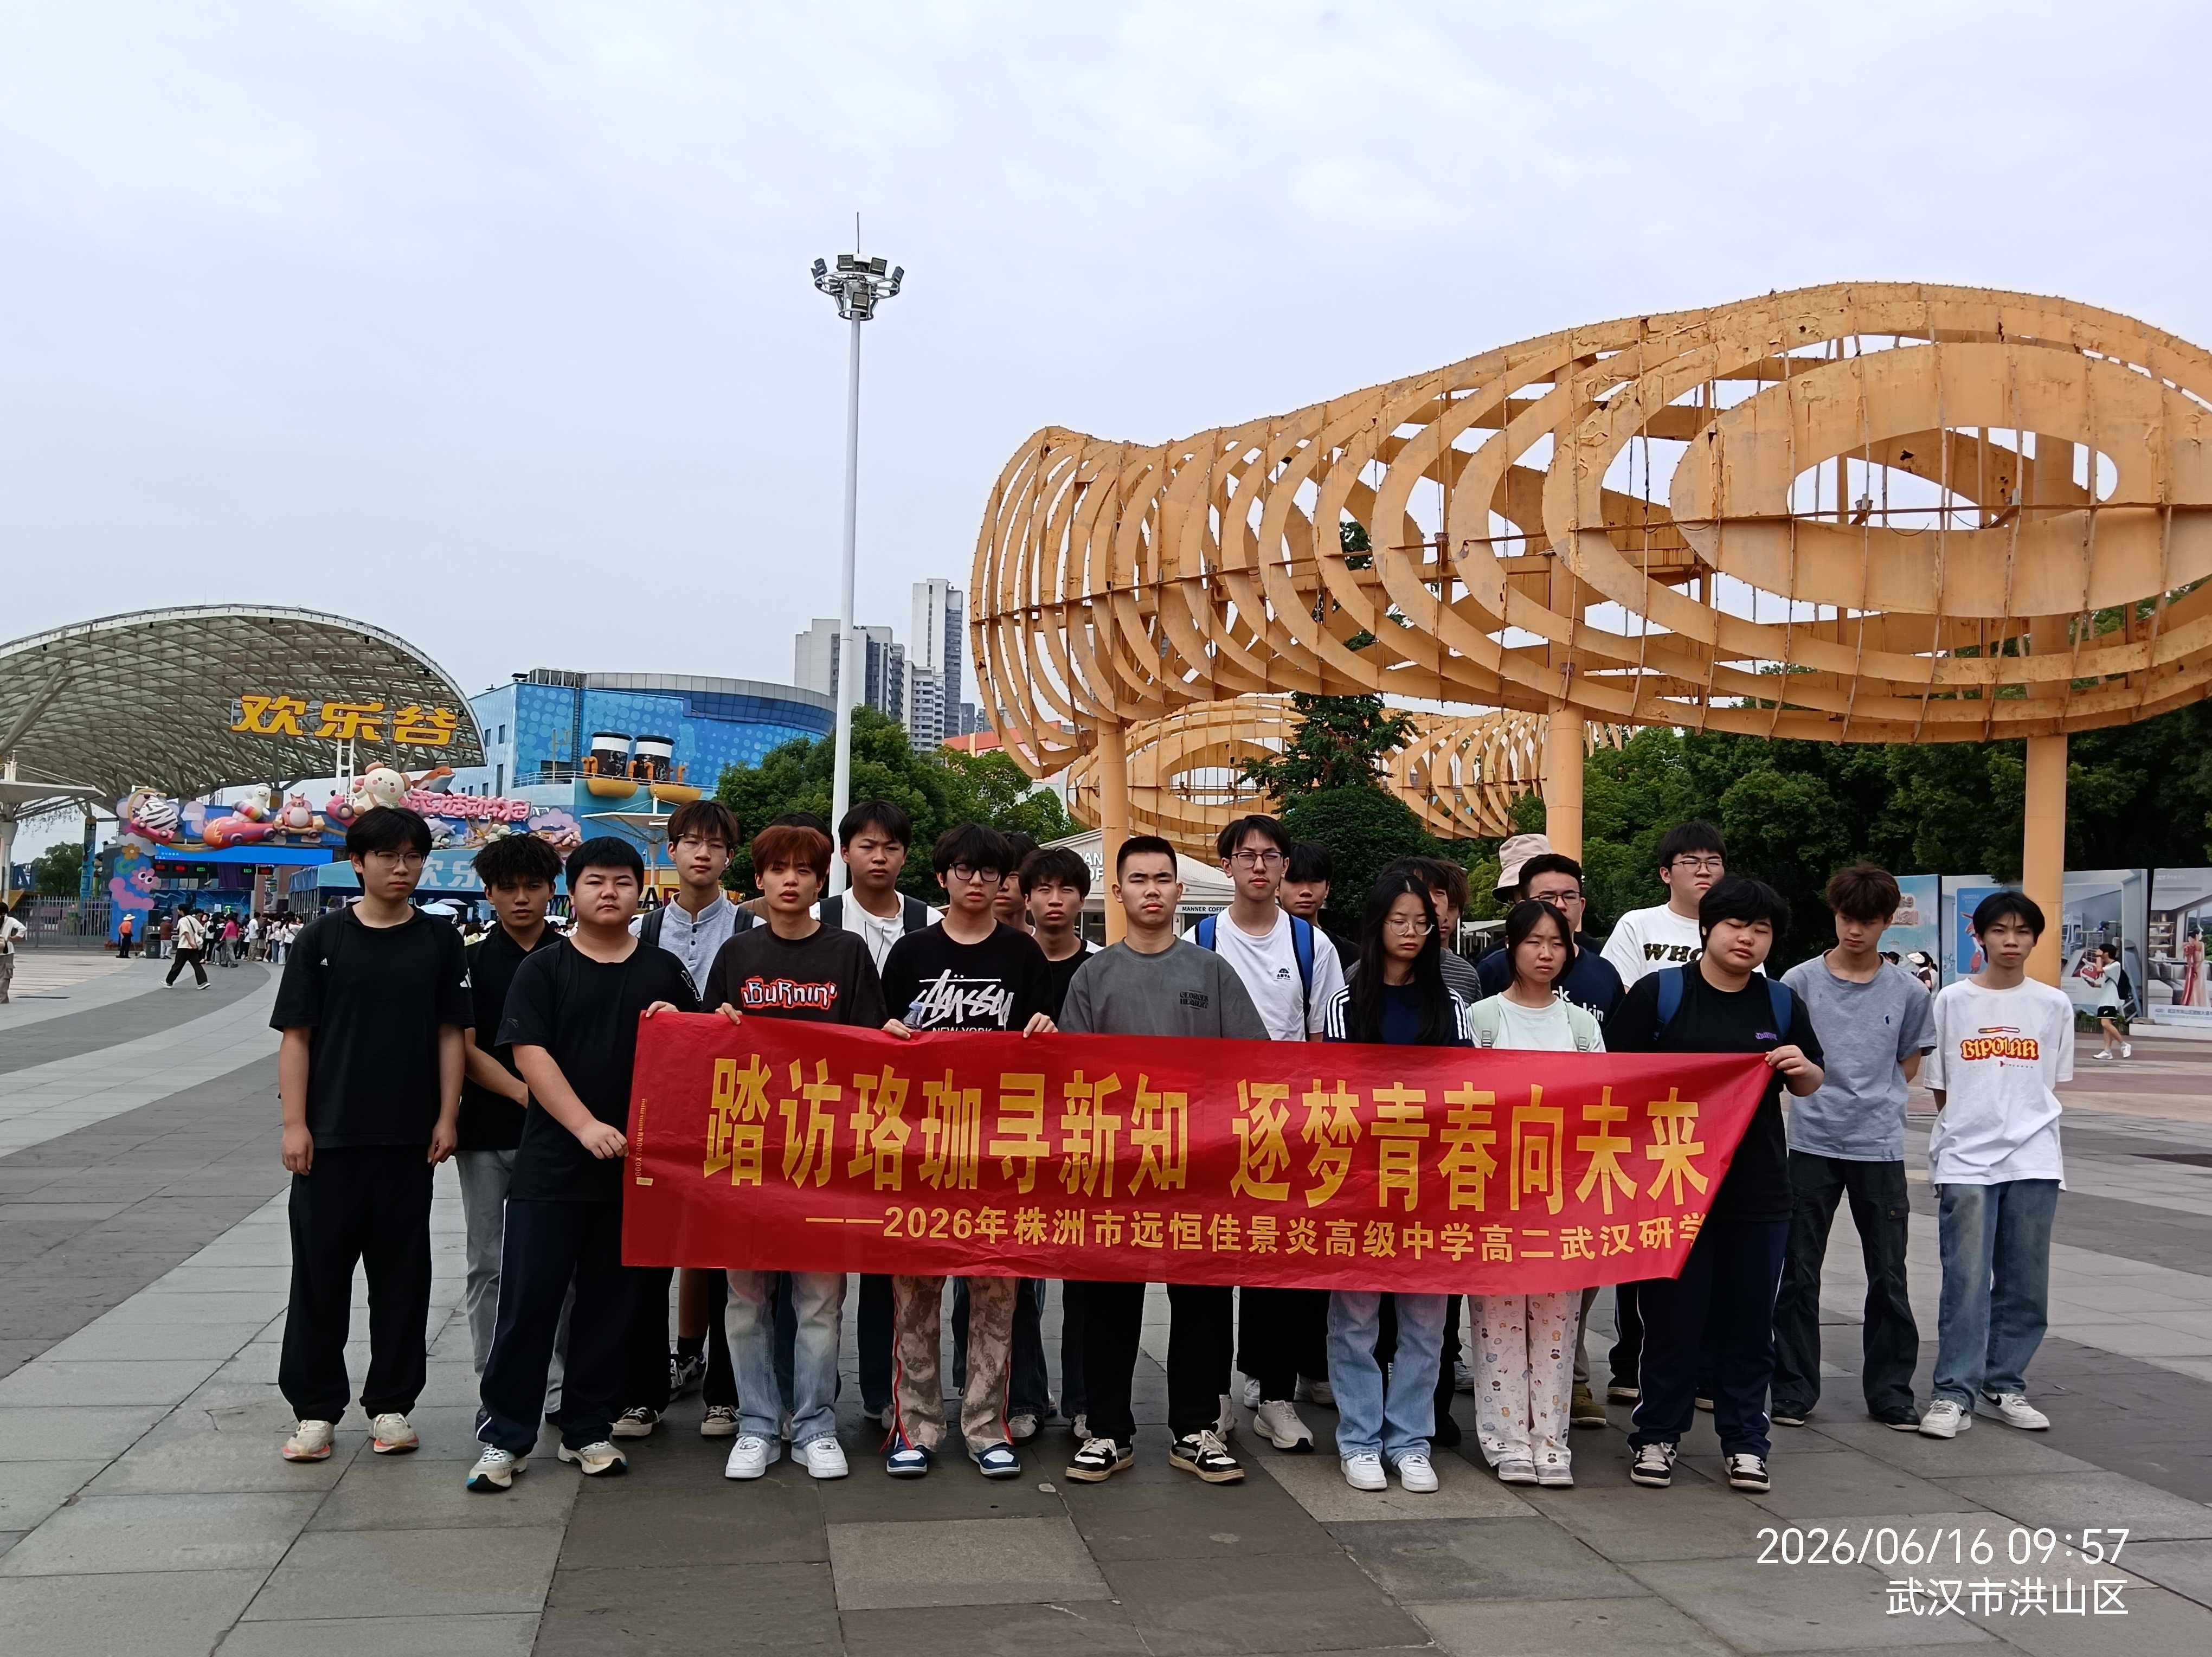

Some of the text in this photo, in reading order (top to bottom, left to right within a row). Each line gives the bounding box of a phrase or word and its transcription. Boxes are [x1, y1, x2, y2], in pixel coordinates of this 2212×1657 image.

[232, 695, 458, 746] 欢乐谷
[1079, 852, 1103, 865] AN
[703, 1054, 1708, 1215] 踏访珞珈寻新知 逐梦青春向未来
